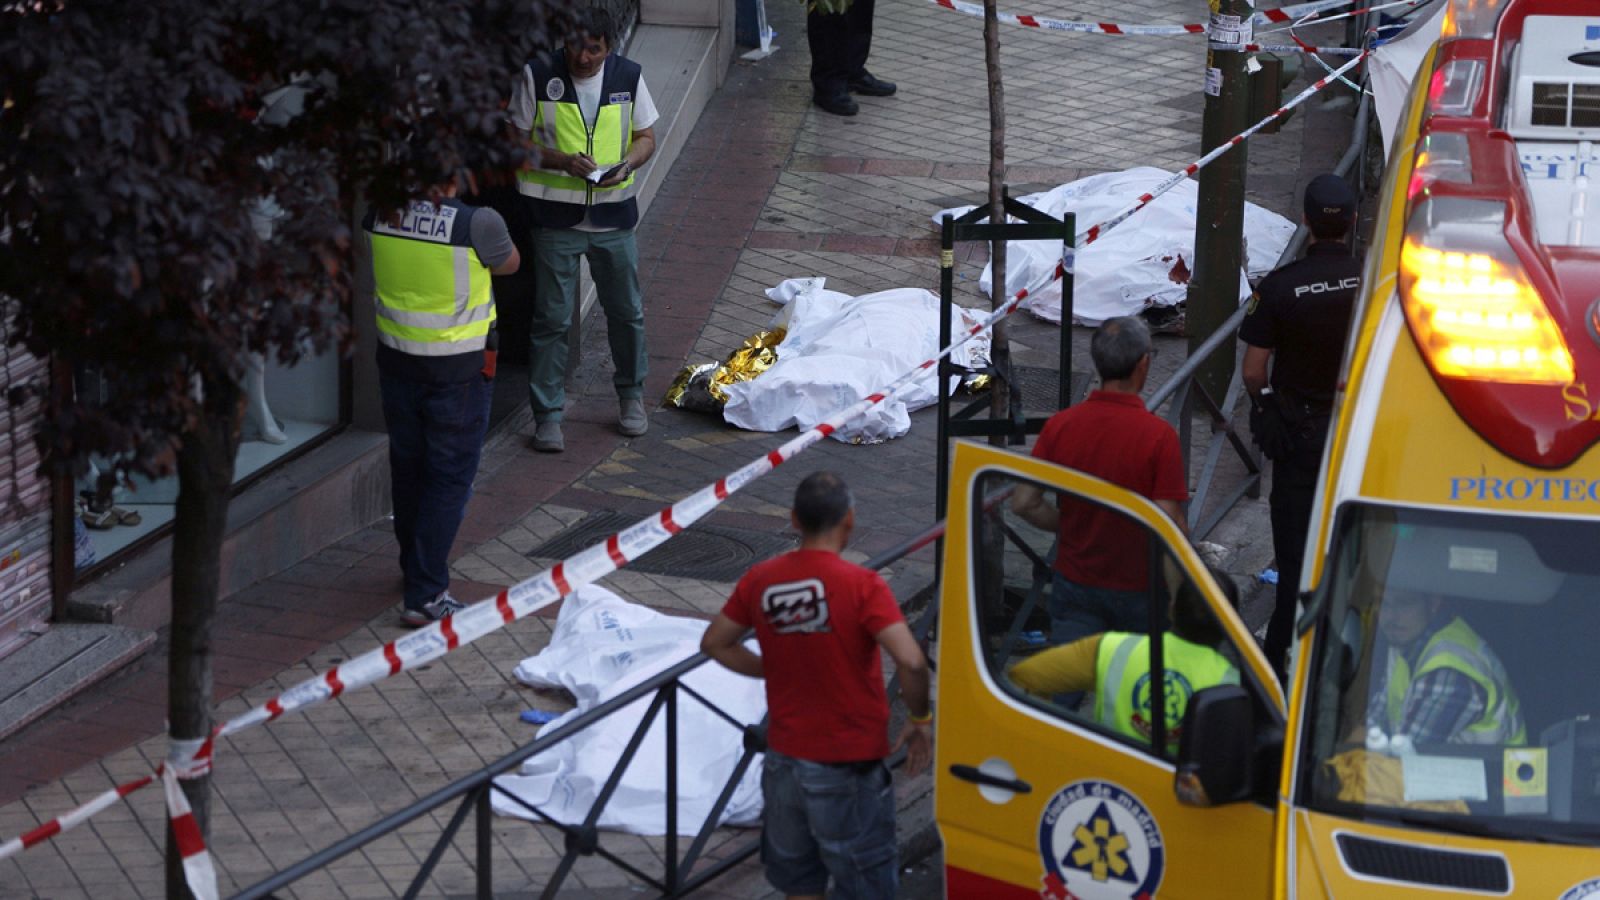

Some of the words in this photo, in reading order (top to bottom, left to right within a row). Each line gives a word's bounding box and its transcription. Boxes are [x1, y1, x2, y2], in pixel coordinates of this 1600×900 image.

[376, 211, 447, 237] LICIA
[1045, 784, 1086, 825] ciudad
[1091, 783, 1113, 797] de
[1117, 793, 1161, 848] madrid
